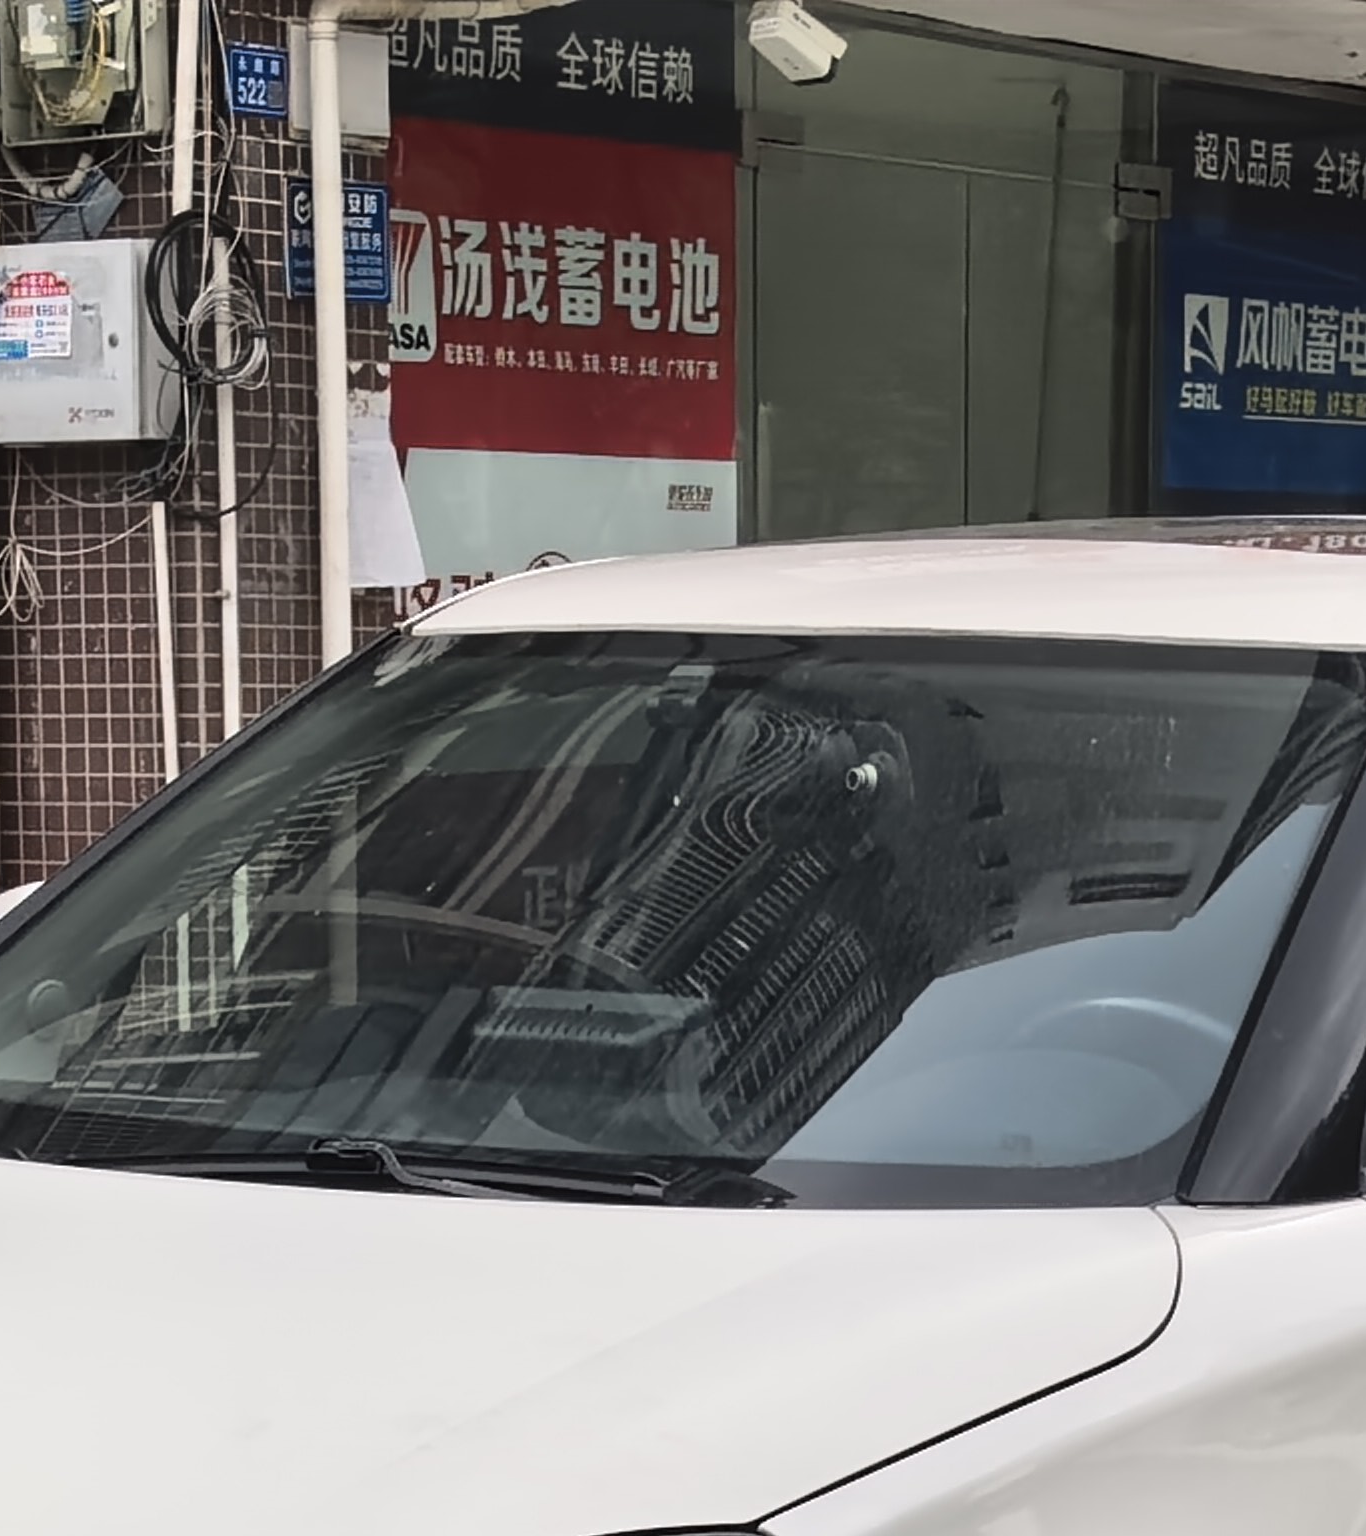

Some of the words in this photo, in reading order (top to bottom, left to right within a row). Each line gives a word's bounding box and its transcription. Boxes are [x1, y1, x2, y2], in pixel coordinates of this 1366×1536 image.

[237, 77, 267, 106] 522
[555, 31, 694, 104] 全球信赖
[1193, 129, 1294, 190] 超凡品质
[438, 215, 720, 335] 汤浅蓄电池
[389, 322, 431, 352] ASA
